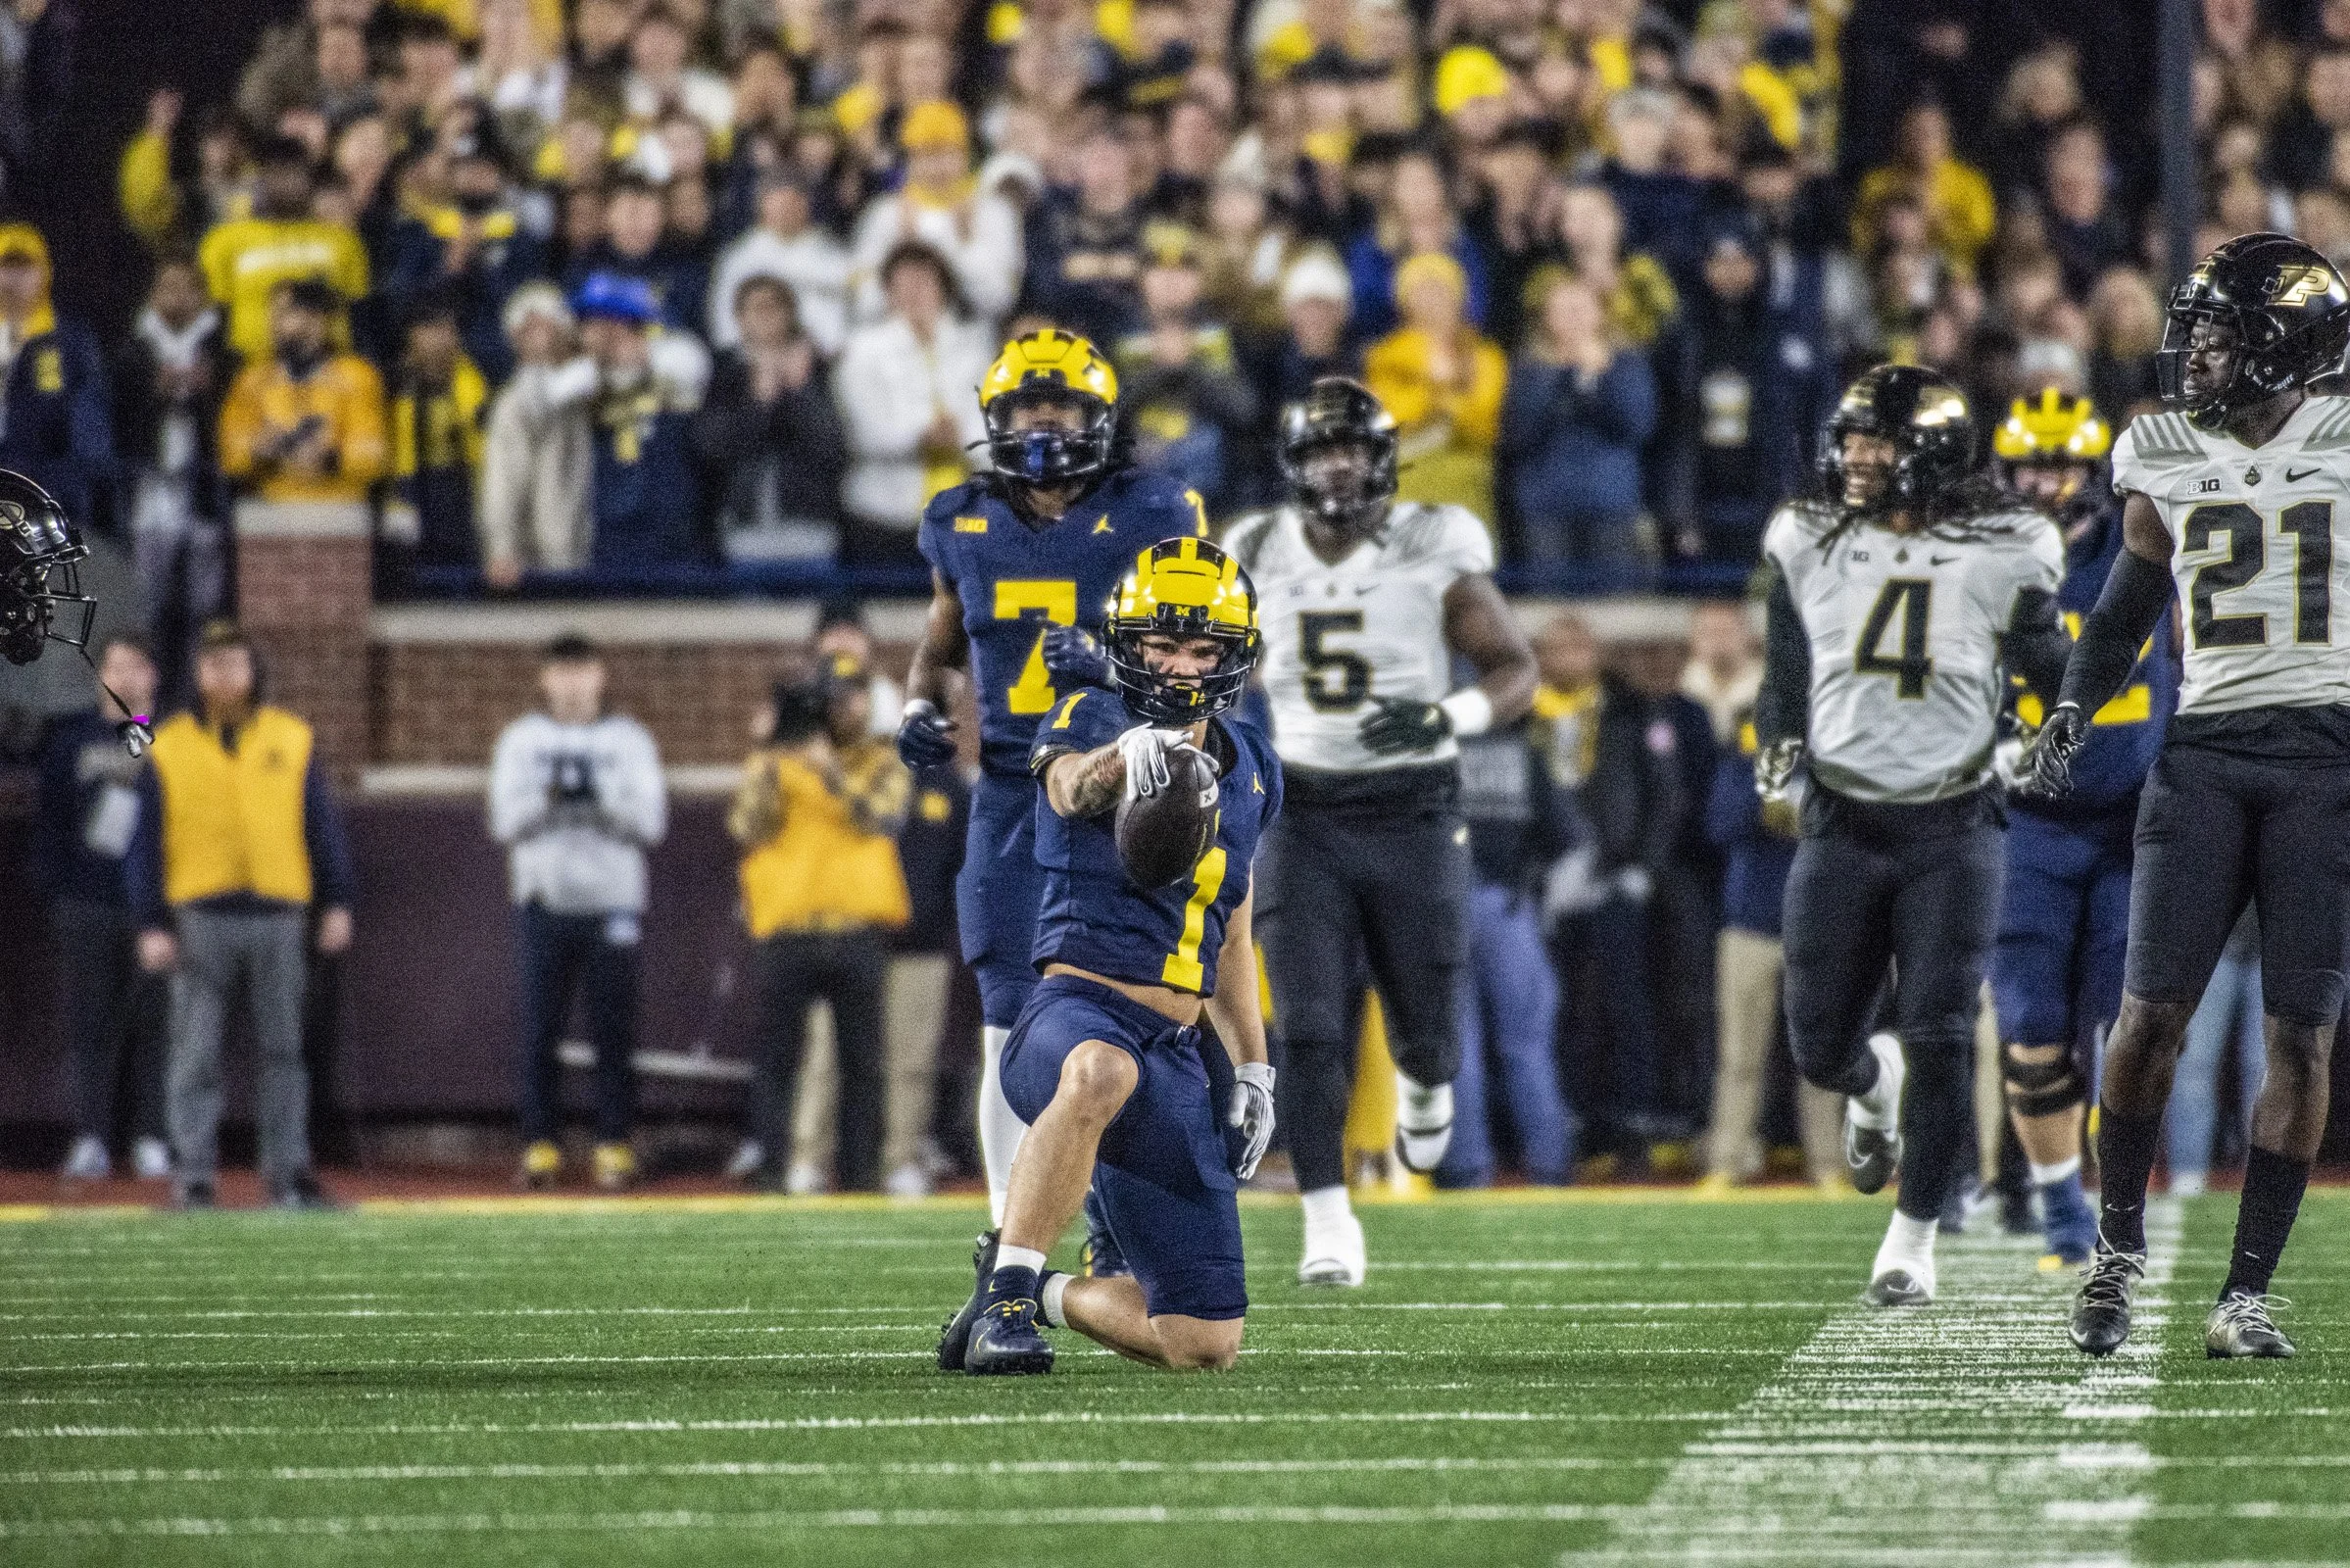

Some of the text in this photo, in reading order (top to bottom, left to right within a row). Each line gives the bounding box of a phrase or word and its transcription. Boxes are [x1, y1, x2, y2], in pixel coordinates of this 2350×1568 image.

[1176, 605, 1191, 616] M
[1854, 574, 1934, 700] 4
[2180, 498, 2336, 652] 21
[994, 578, 1077, 714] 7
[1298, 609, 1374, 714] 5
[1052, 692, 1088, 729] 1
[1162, 847, 1227, 993] 1
